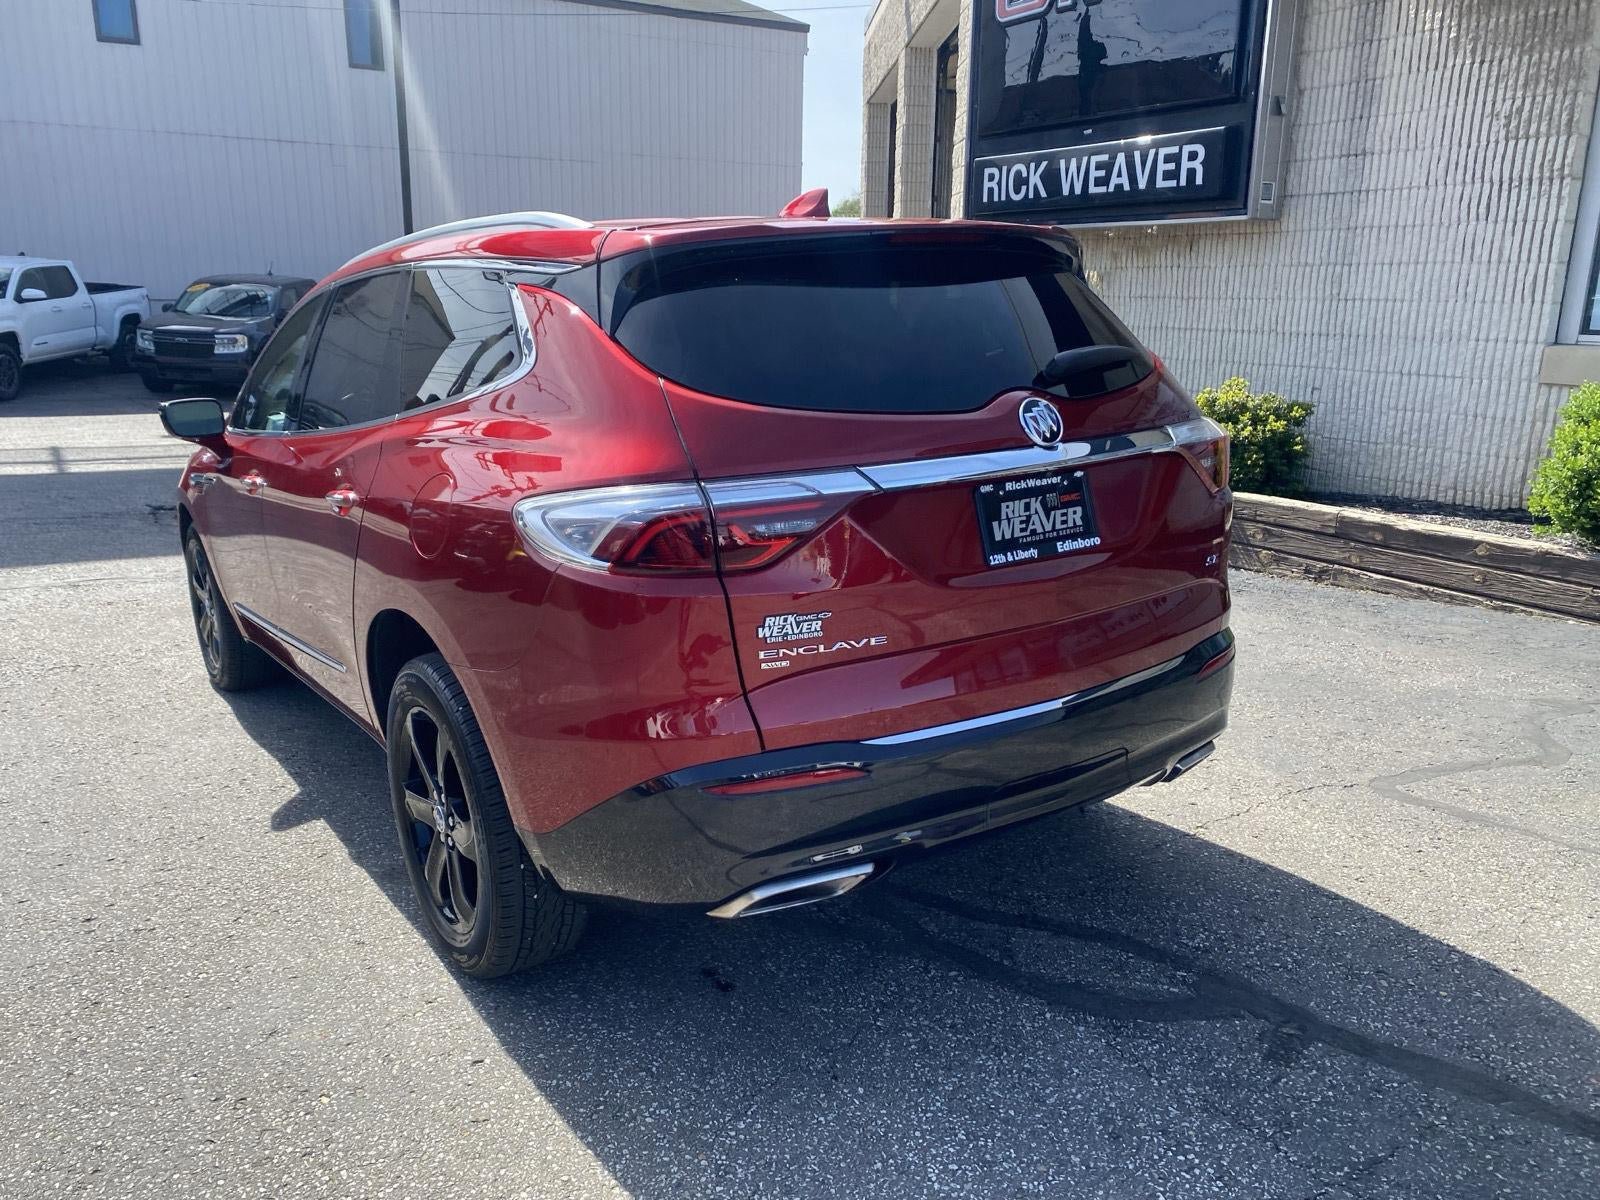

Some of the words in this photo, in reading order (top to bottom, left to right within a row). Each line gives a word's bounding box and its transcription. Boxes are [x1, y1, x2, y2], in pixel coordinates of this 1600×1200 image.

[982, 160, 1048, 203] RICK
[1060, 143, 1206, 196] WEAVER
[1006, 477, 1061, 491] RickWeaver
[1000, 496, 1043, 520] RICK
[992, 507, 1082, 541] WEAVER
[1056, 536, 1101, 552] Edinboro
[989, 554, 1007, 565] 12th
[1007, 552, 1014, 562] &
[1013, 547, 1038, 560] Liberty
[758, 620, 822, 638] WEAVER
[765, 614, 797, 627] RICK
[787, 631, 824, 641] EDINBORO
[758, 636, 887, 659] ENCLAVE
